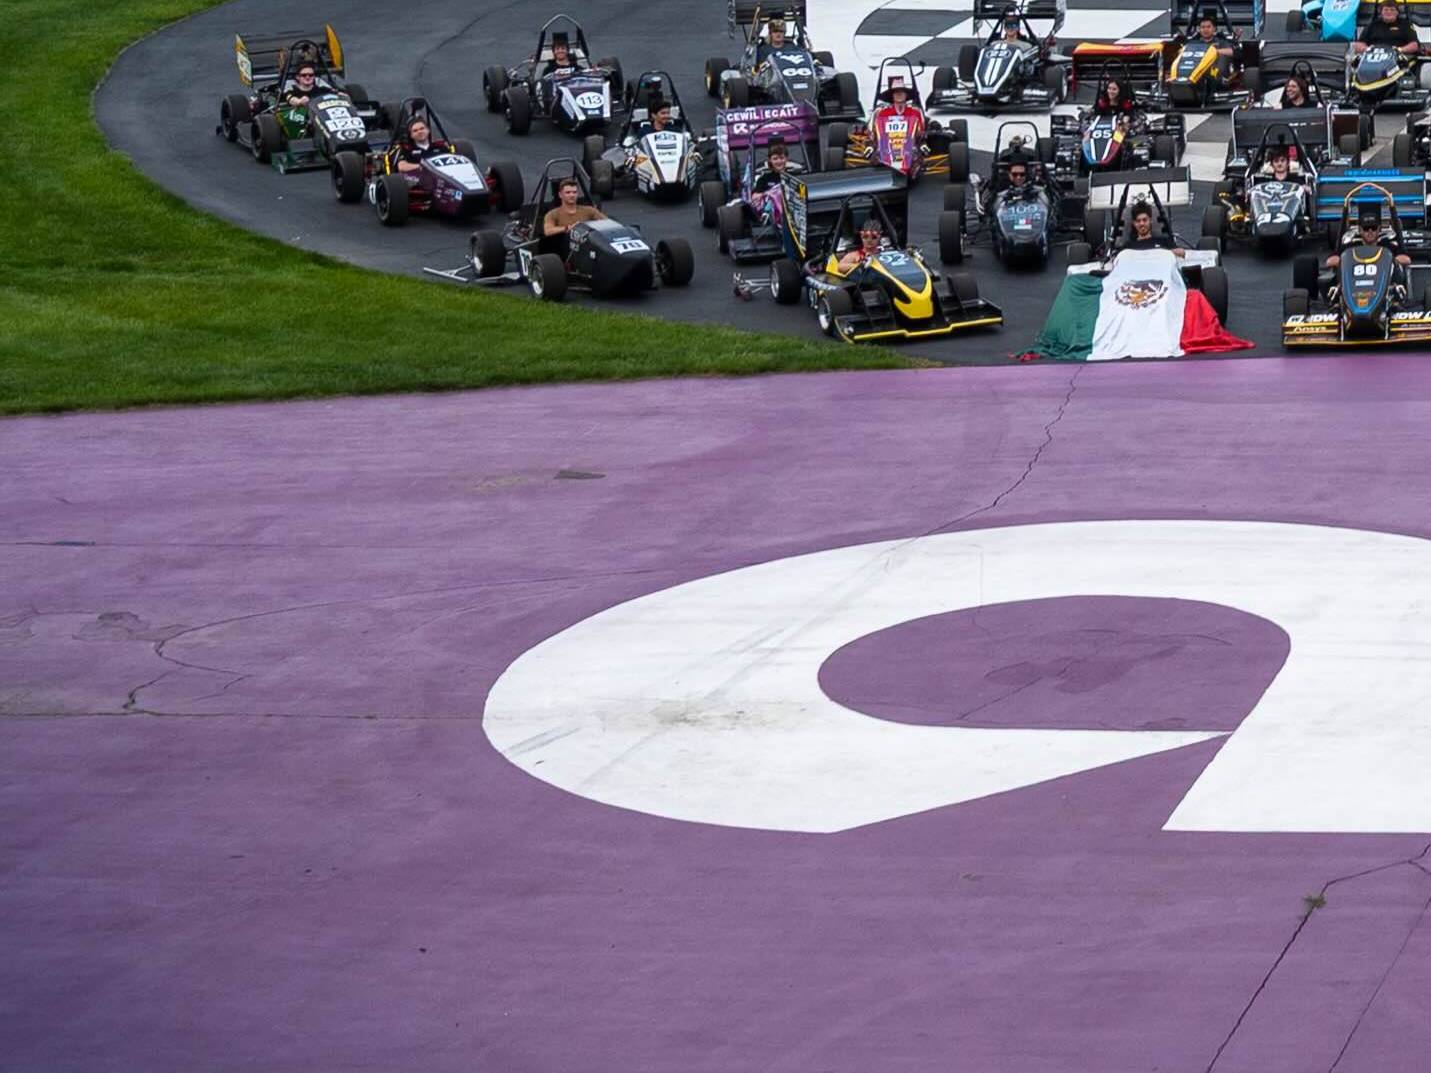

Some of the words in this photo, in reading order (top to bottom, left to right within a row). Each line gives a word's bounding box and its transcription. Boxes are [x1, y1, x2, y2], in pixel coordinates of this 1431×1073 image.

[580, 95, 602, 106] 113
[726, 109, 761, 122] CEWIL
[765, 107, 799, 119] ECAIT
[888, 122, 909, 132] 107
[1093, 130, 1112, 139] 65
[1354, 265, 1377, 276] 80
